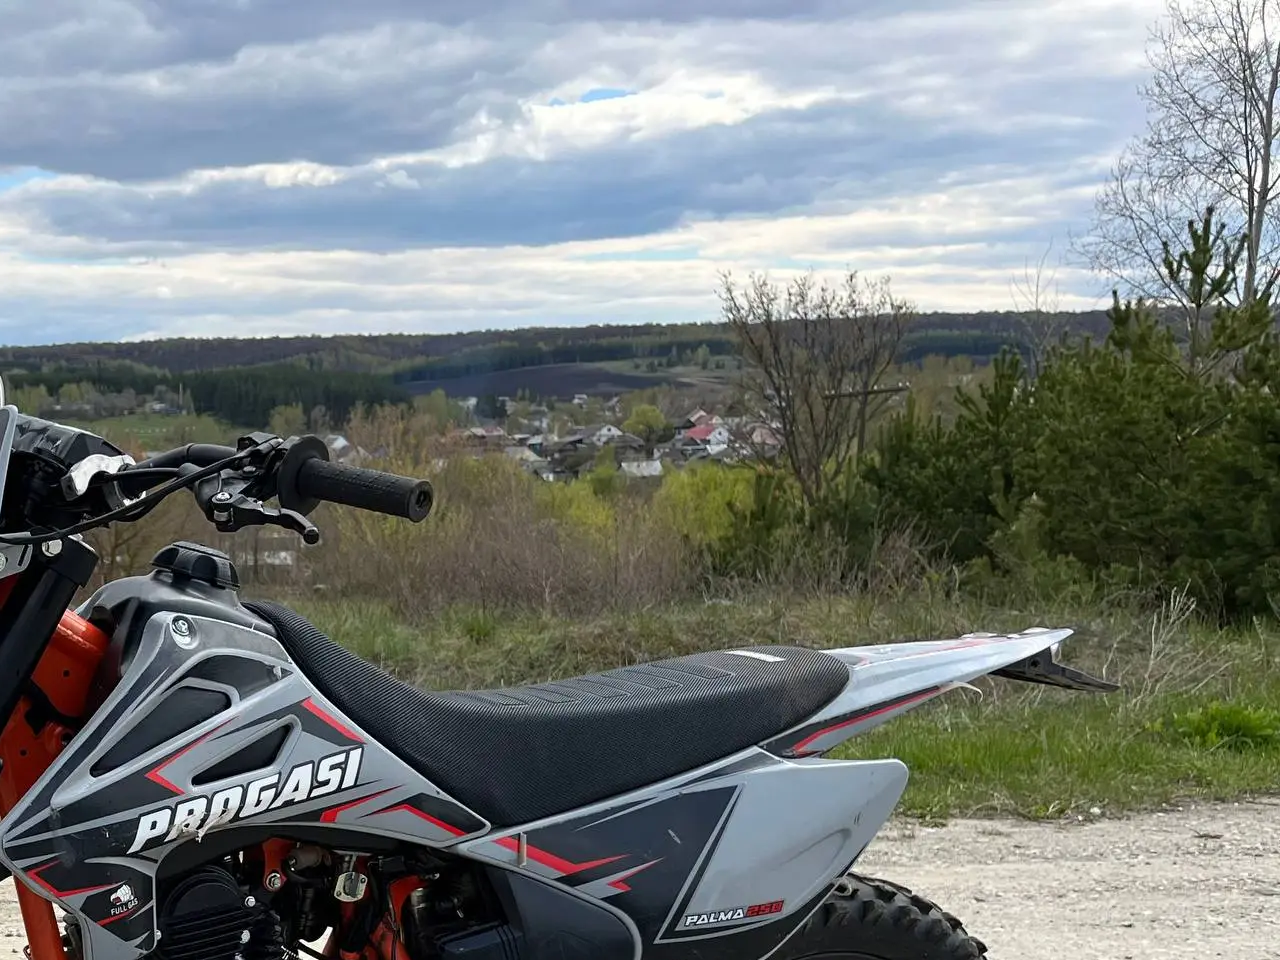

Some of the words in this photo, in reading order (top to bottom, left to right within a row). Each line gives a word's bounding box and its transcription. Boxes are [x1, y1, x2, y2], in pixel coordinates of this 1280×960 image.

[126, 747, 363, 854] PROGASI
[110, 905, 127, 915] FULL
[685, 908, 744, 926] PALMA
[746, 901, 783, 917] 250
